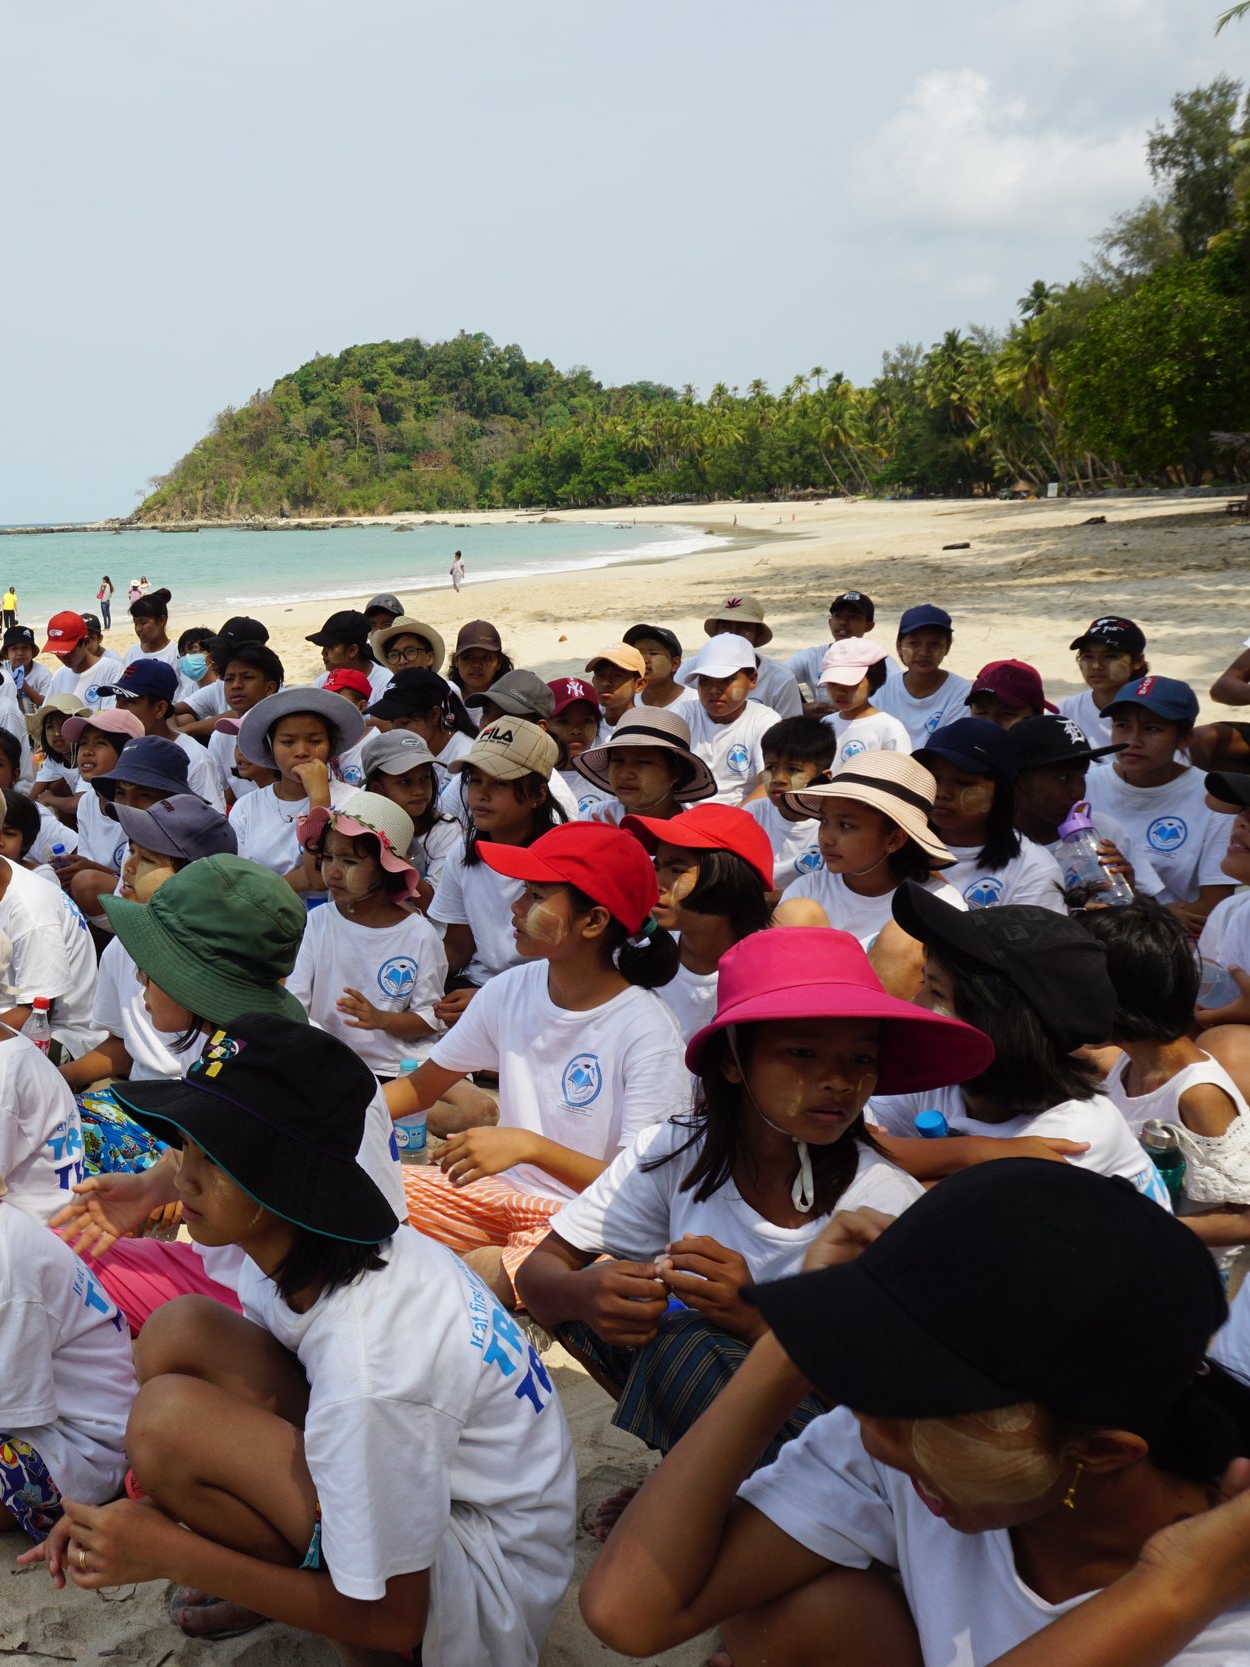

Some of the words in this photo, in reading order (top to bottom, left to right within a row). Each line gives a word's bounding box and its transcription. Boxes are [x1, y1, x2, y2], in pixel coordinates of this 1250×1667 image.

[480, 727, 514, 743] FILA
[46, 1126, 83, 1161] TR
[470, 1314, 489, 1333] at
[470, 1331, 484, 1350] If
[483, 1296, 523, 1377] TR
